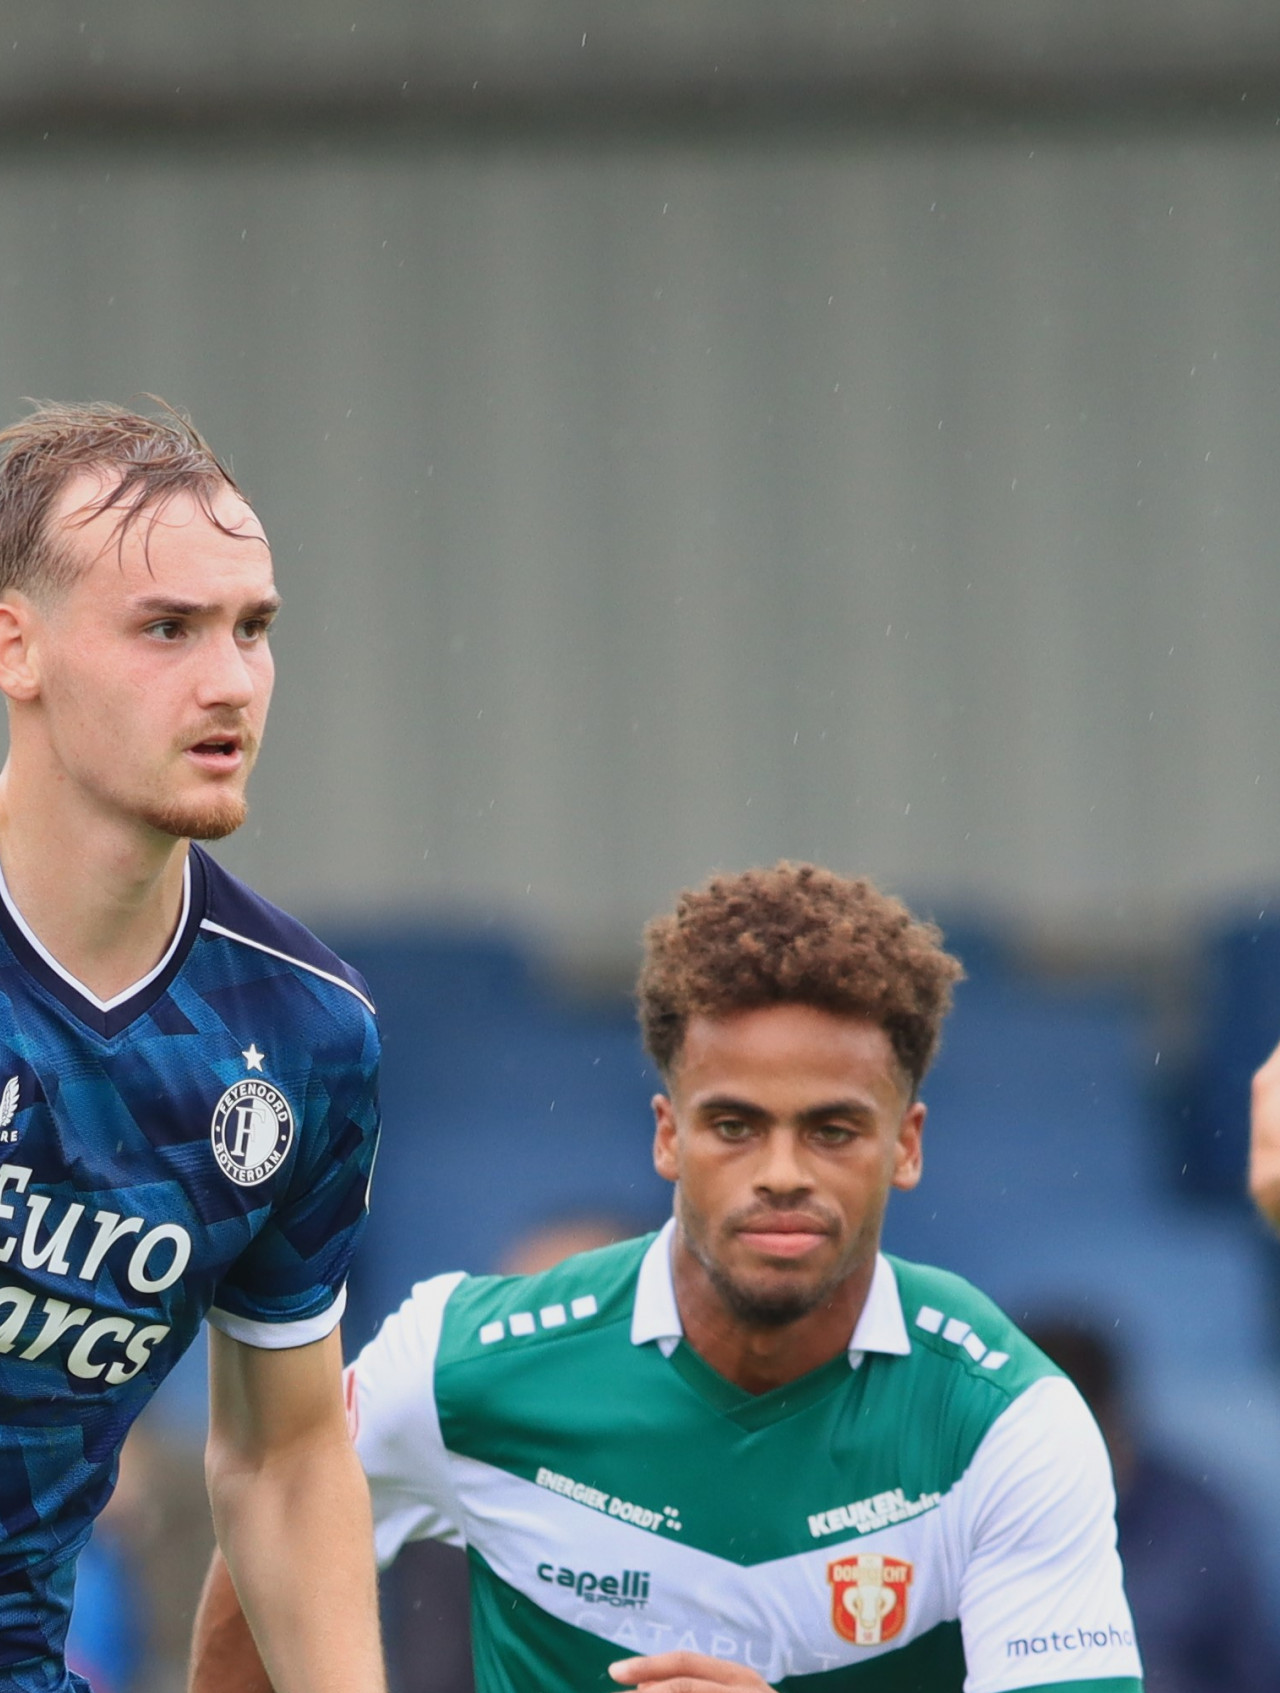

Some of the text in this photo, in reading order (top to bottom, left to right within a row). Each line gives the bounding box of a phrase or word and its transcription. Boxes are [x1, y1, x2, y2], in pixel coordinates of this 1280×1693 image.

[220, 1083, 289, 1122] FEYENOORD
[215, 1143, 282, 1181] ROTTERDAM
[535, 1466, 665, 1532] ENERGIEK DORDT
[807, 1487, 907, 1539] KEUKEN
[537, 1562, 651, 1599] capelli
[833, 1564, 909, 1583] DORCHT
[583, 1591, 649, 1611] SPORT
